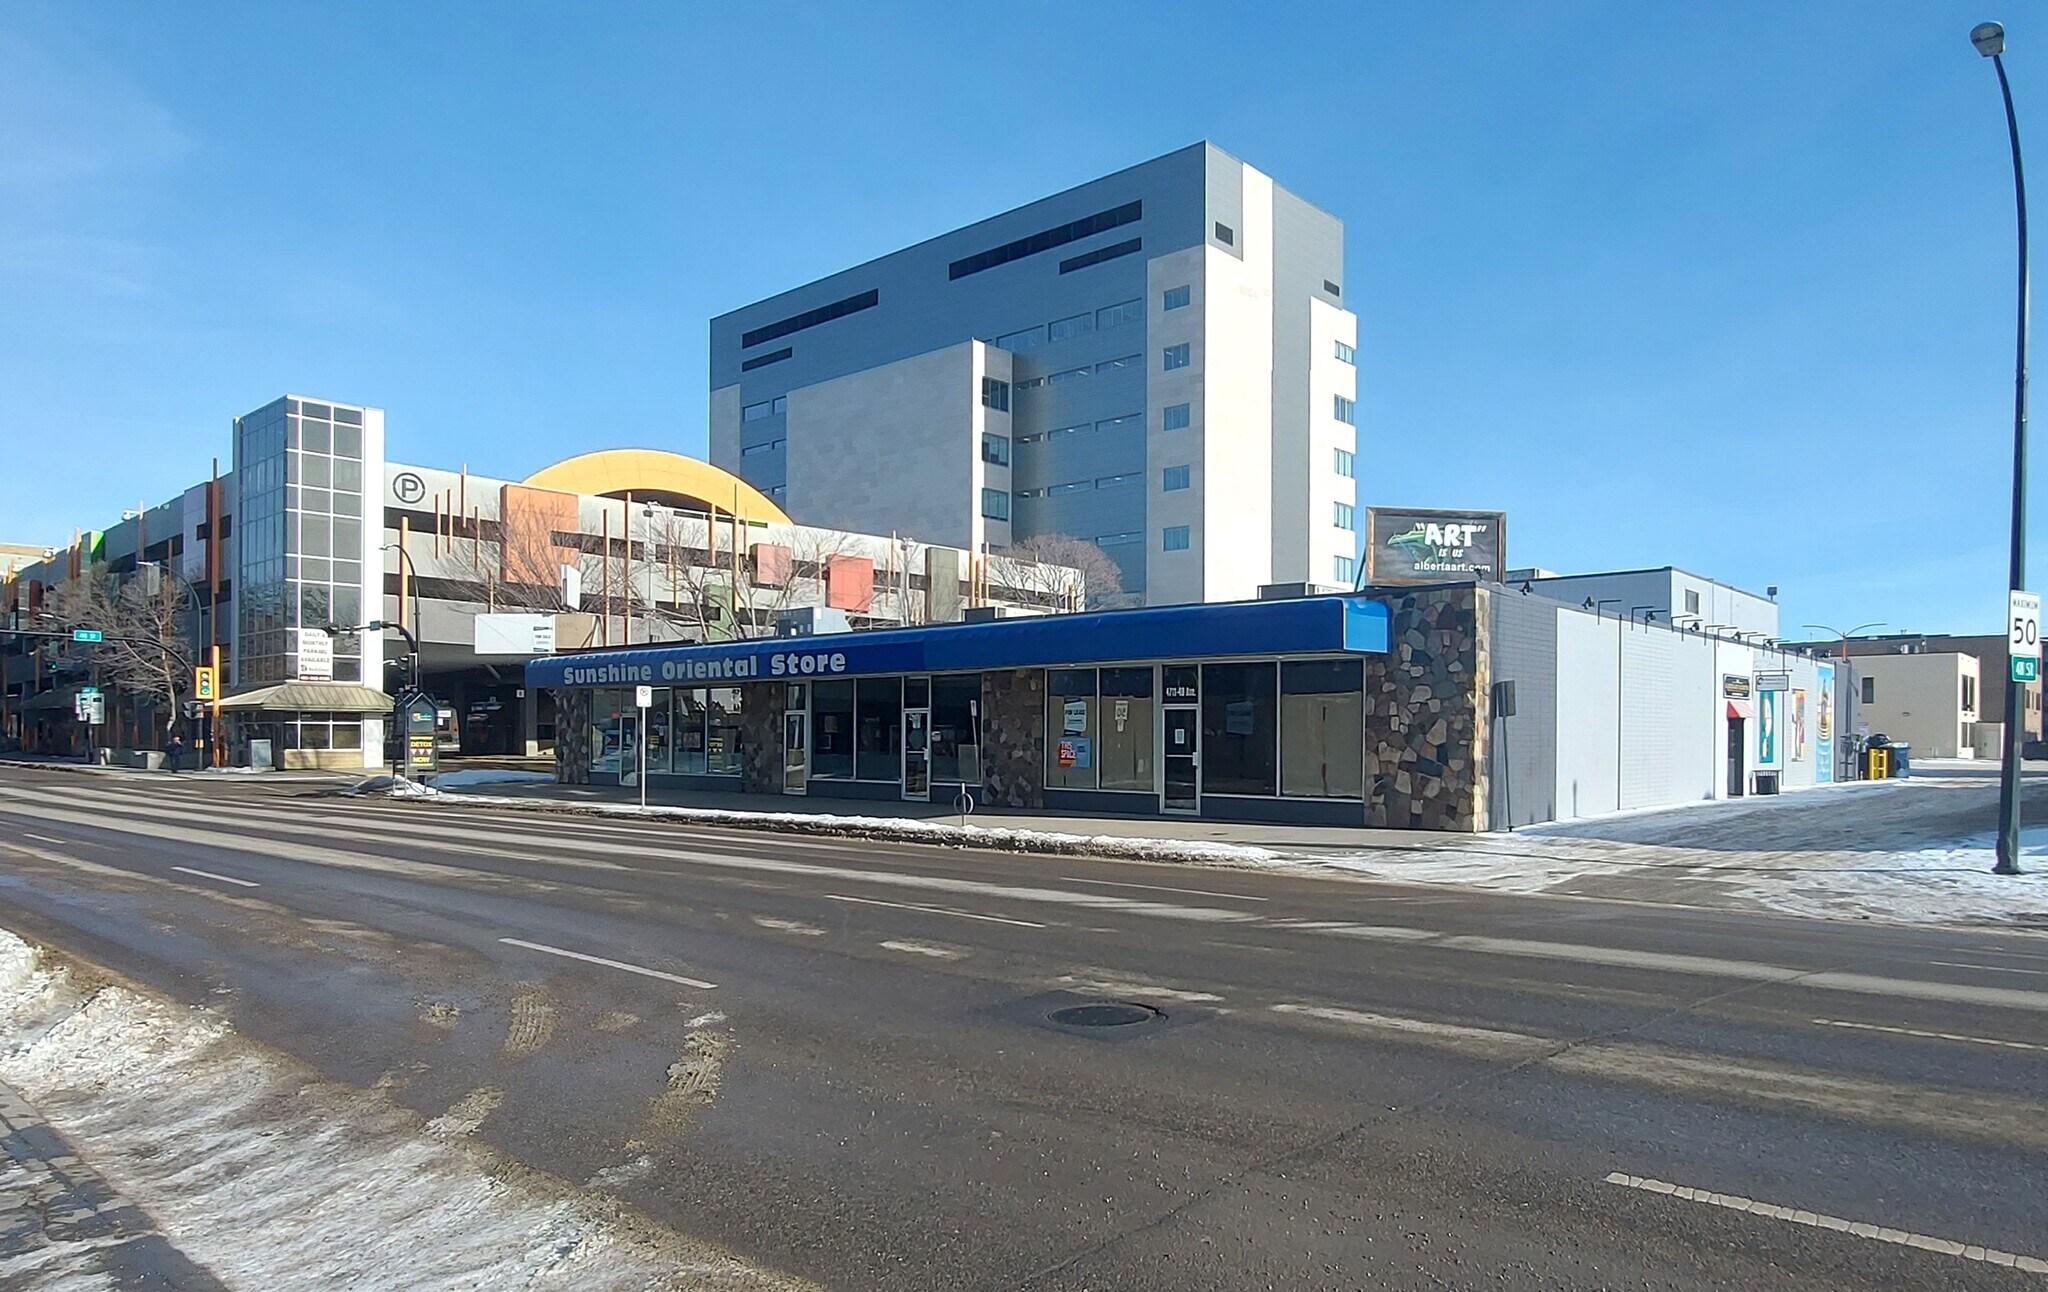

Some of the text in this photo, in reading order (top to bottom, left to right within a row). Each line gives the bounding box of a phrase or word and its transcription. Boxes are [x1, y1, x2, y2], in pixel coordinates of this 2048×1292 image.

[1452, 548, 1464, 558] US
[2012, 598, 2038, 610] MAXIMUM
[2013, 617, 2037, 646] 50
[563, 653, 846, 685] Sunshine Oriental Store
